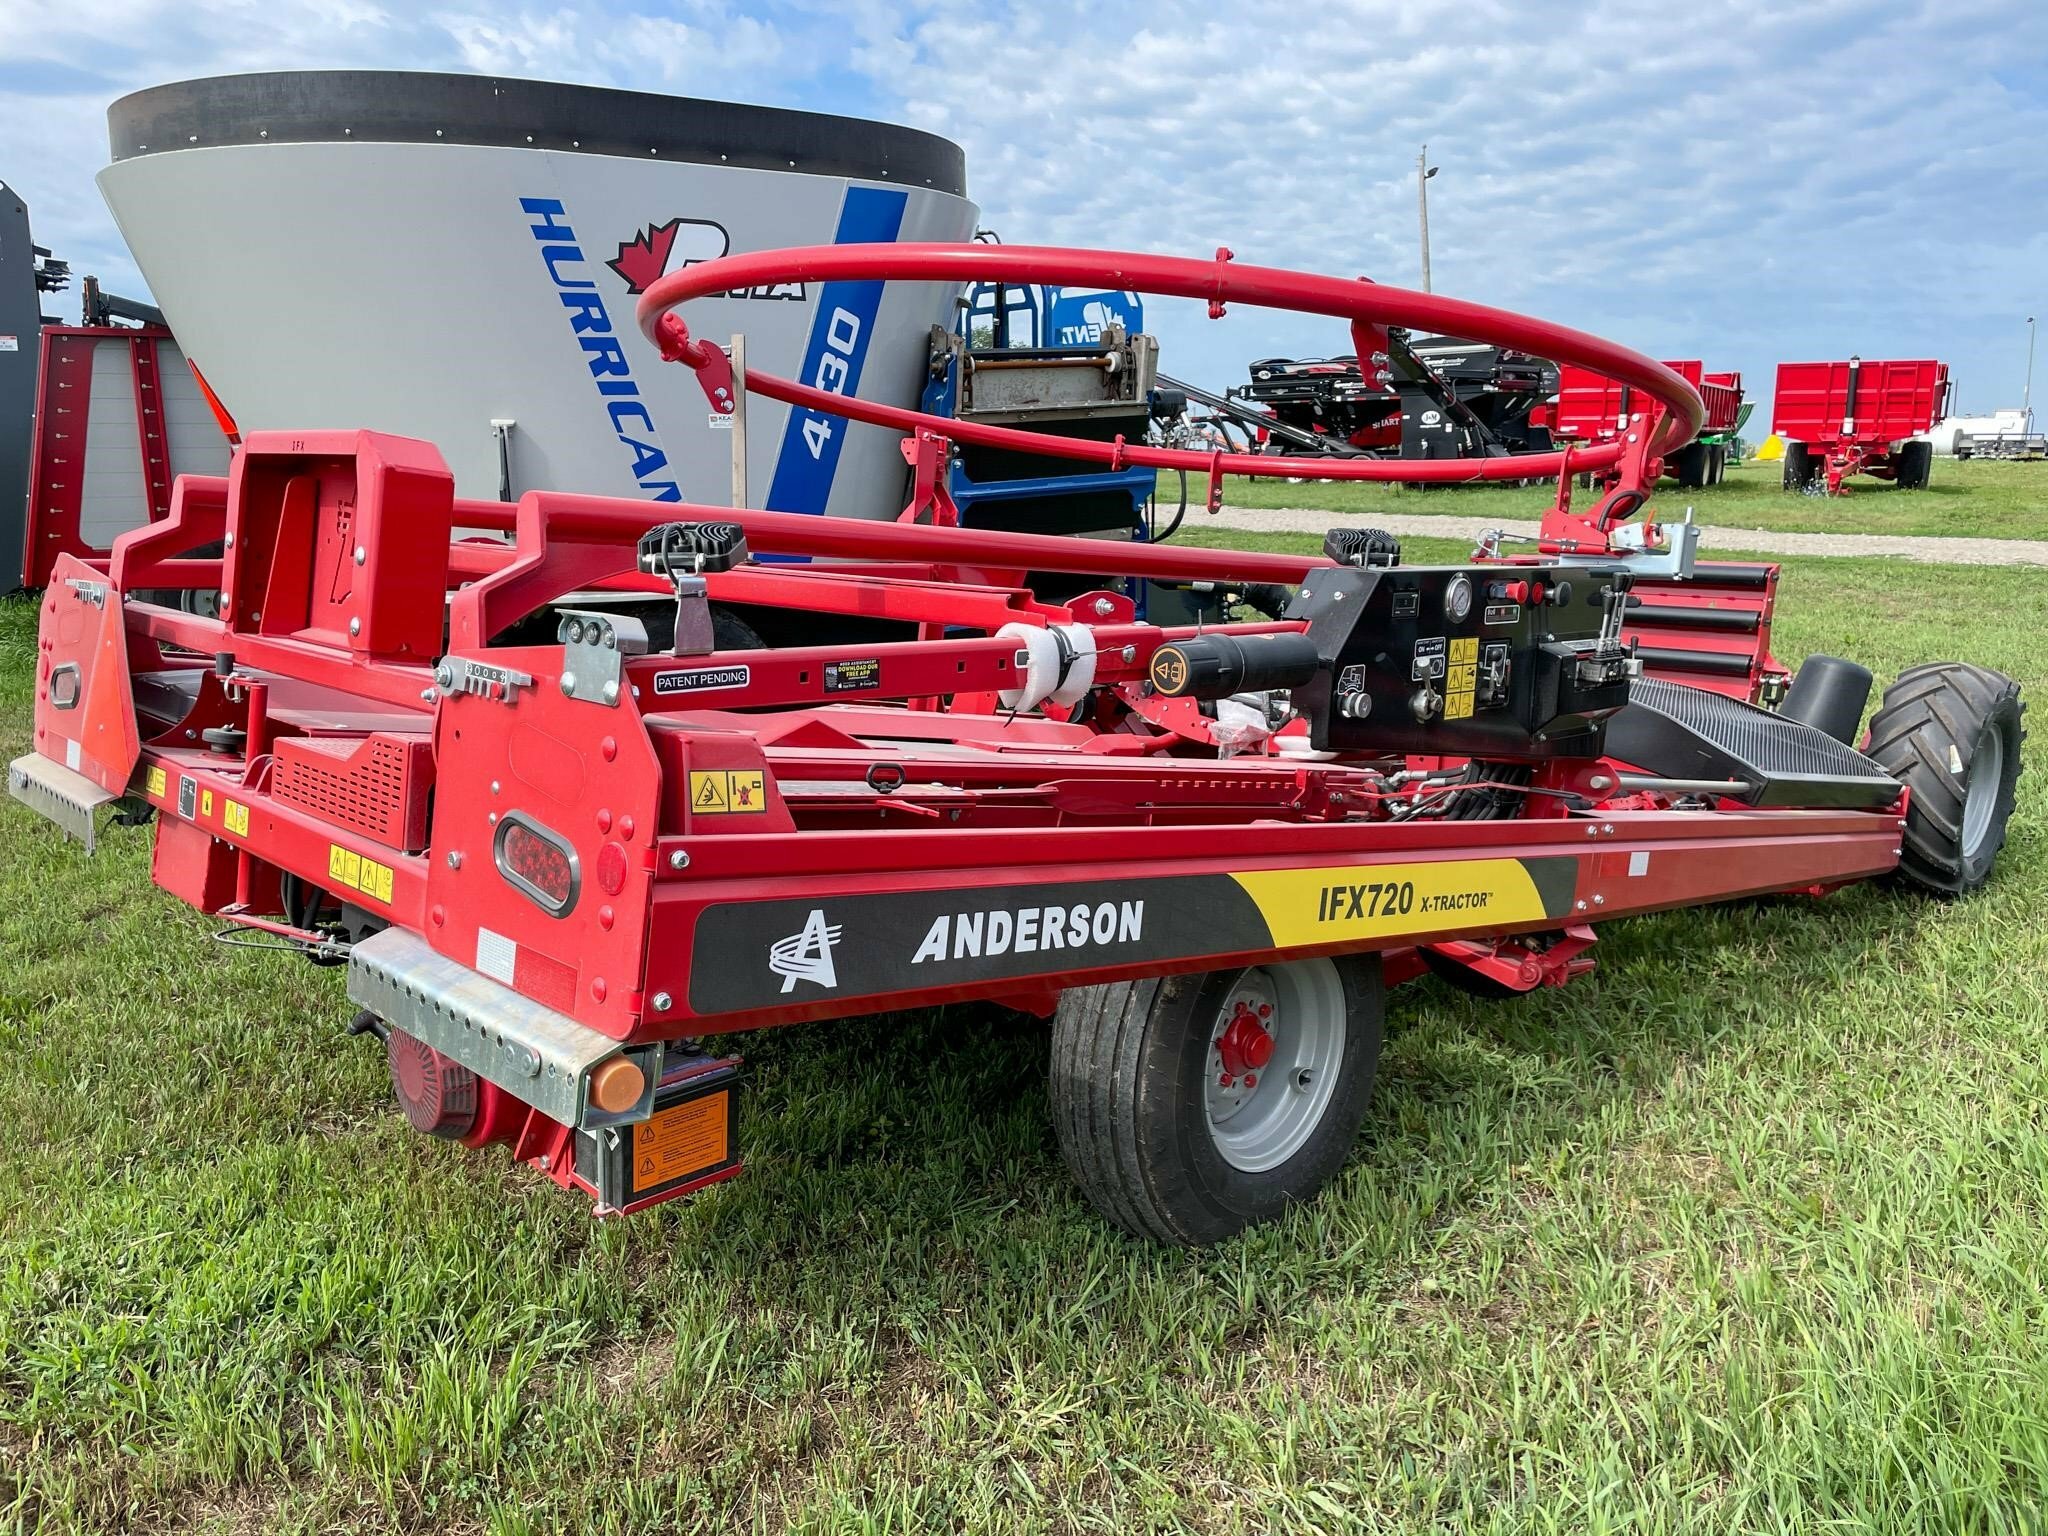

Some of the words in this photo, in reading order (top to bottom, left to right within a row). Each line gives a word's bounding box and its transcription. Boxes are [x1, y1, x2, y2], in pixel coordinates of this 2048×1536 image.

[802, 306, 861, 460] 430
[658, 675, 698, 688] PATENT
[700, 671, 746, 684] PENDING
[1318, 881, 1414, 922] IFX720
[910, 900, 1144, 964] ANDERSON
